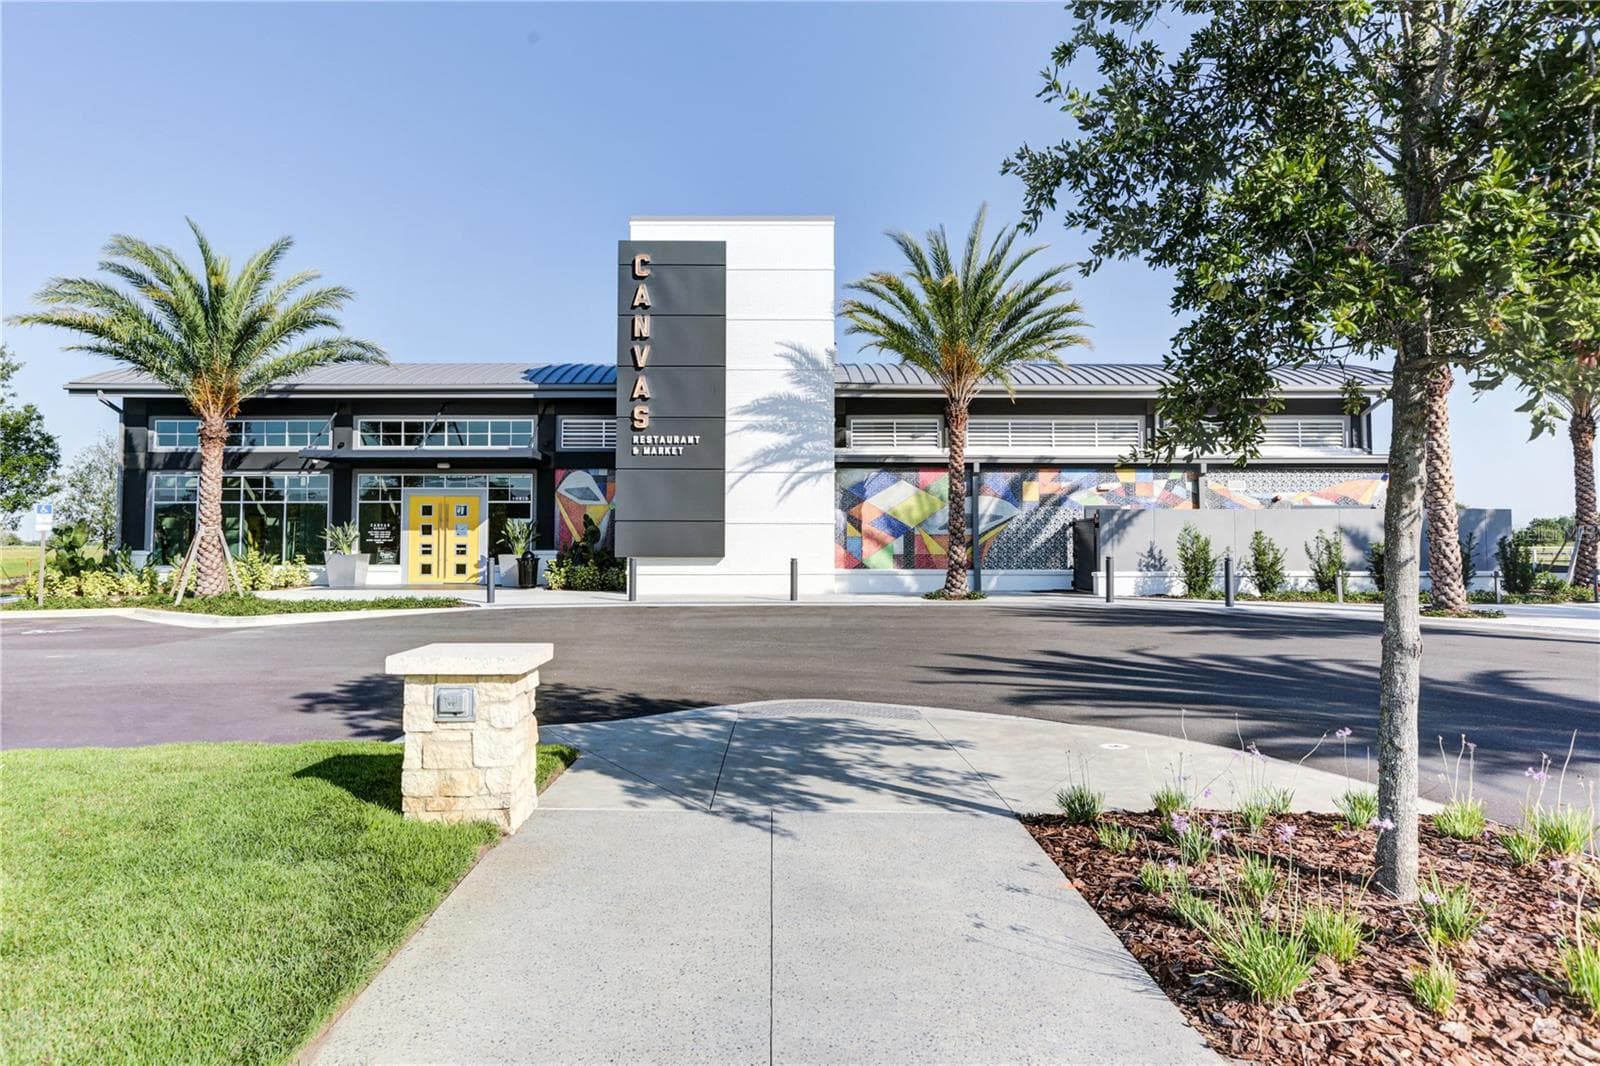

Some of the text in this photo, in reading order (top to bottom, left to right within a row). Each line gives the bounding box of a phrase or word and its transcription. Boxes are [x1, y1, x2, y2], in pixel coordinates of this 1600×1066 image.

[632, 253, 652, 430] CANVAS
[632, 435, 701, 445] RESTAURANT
[632, 446, 684, 455] & MARKET
